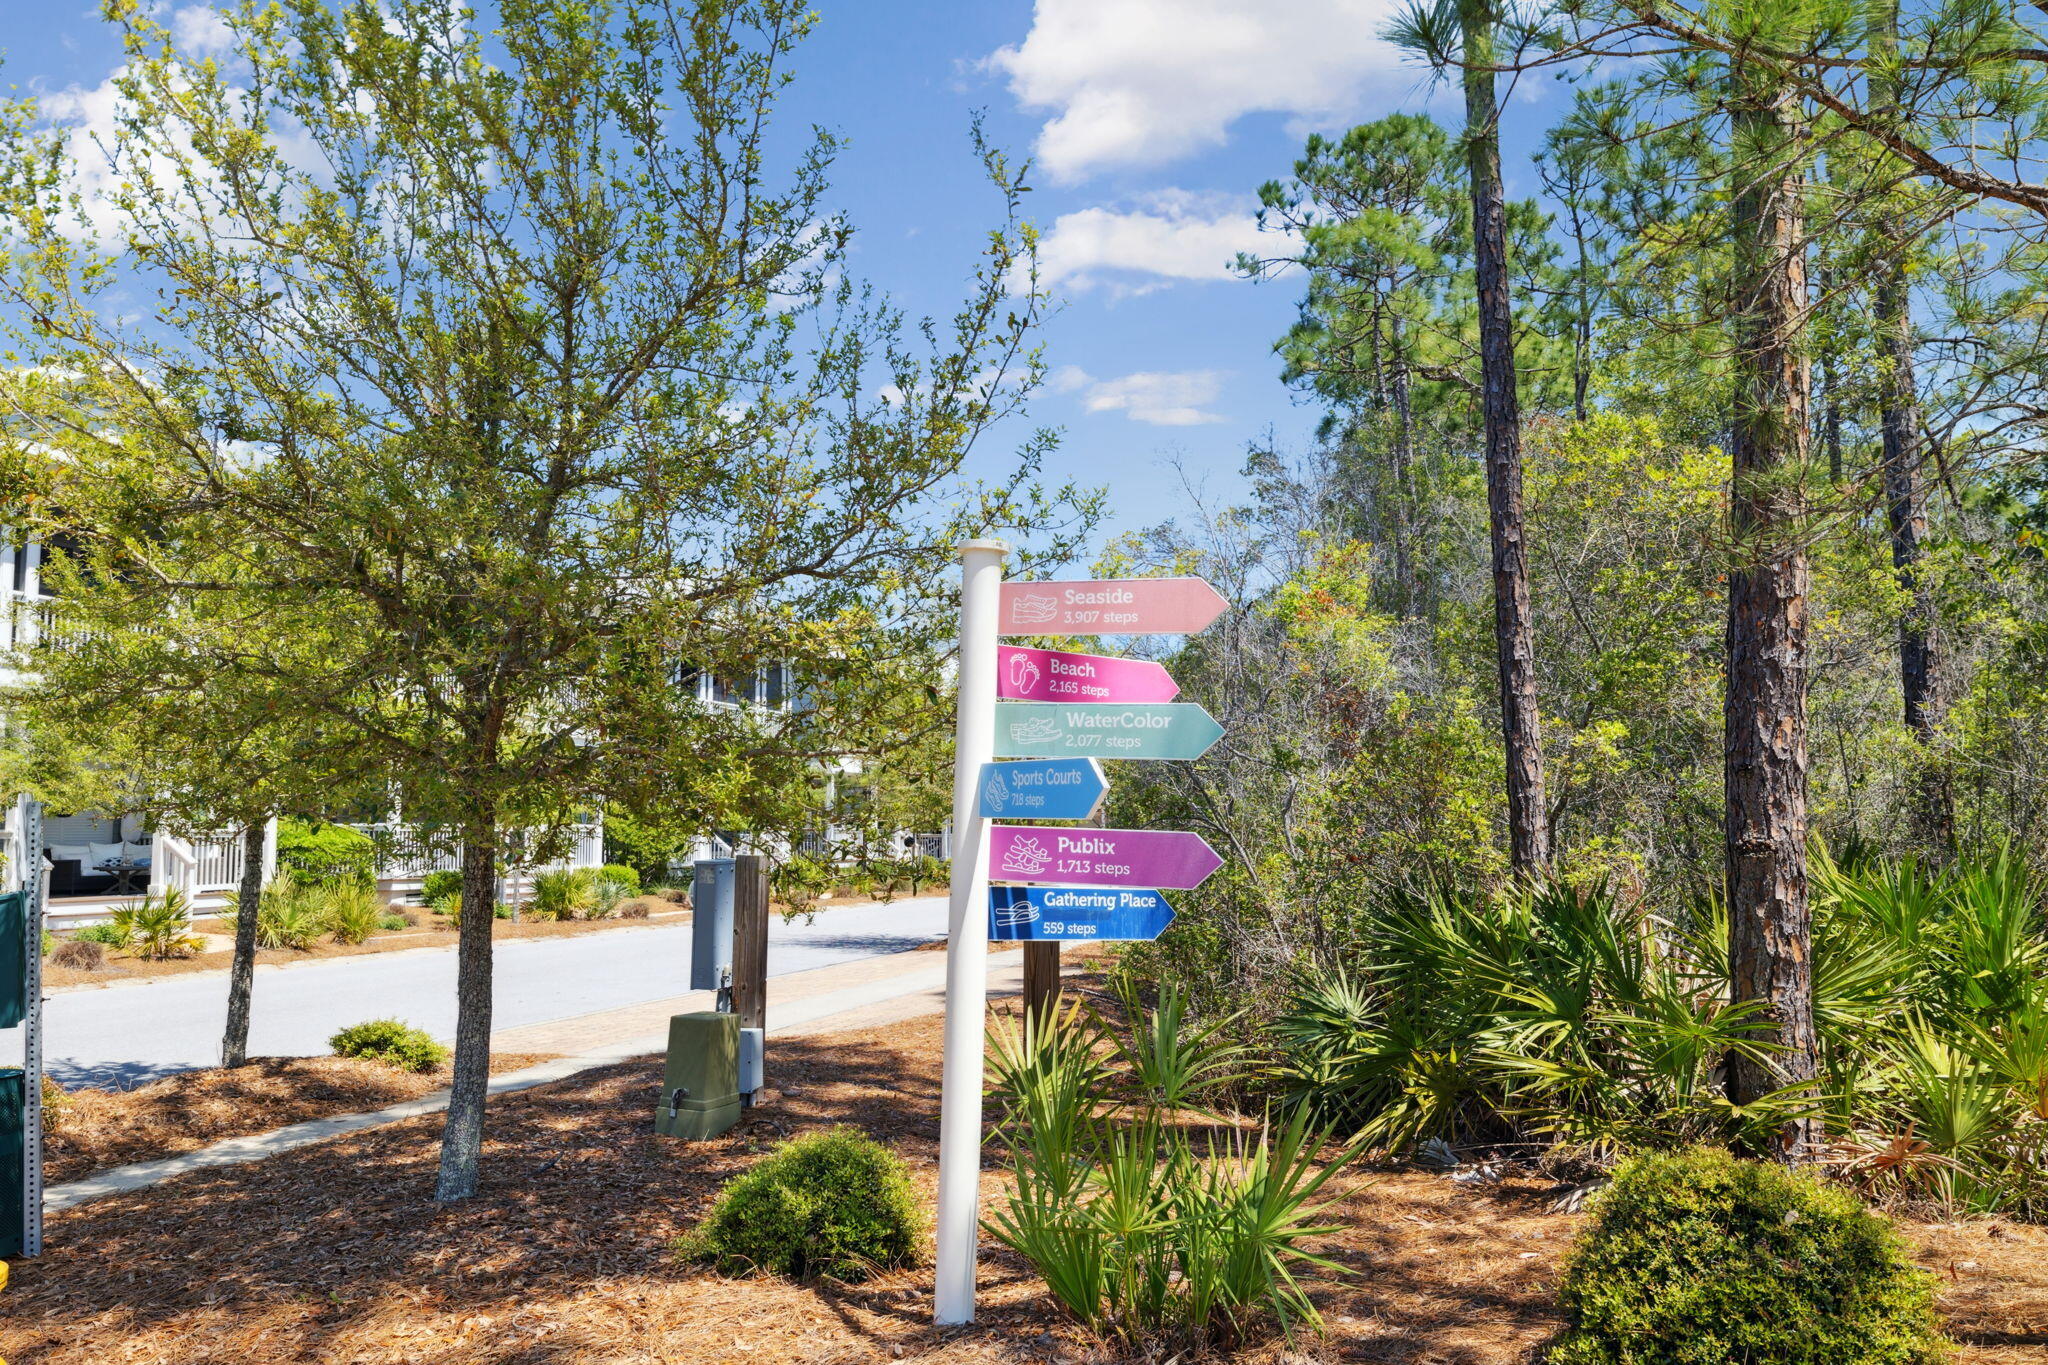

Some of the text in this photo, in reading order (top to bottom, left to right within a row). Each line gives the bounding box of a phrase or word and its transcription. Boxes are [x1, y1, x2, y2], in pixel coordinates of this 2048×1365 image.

[1064, 588, 1133, 604] Seaside
[1064, 610, 1138, 626] 3,907 steps
[1050, 658, 1095, 678] Beach
[1050, 679, 1110, 697] 2,165 steps
[1066, 711, 1172, 729] WaterColor
[1065, 735, 1142, 750] 2,077 steps
[1012, 769, 1081, 787] Sports Courts
[1011, 793, 1045, 807] 718 steps
[1057, 836, 1116, 855] Publix
[1056, 860, 1130, 875] 1,713 steps
[1044, 891, 1156, 910] Gathering Place
[1043, 921, 1096, 936] 559 steps
